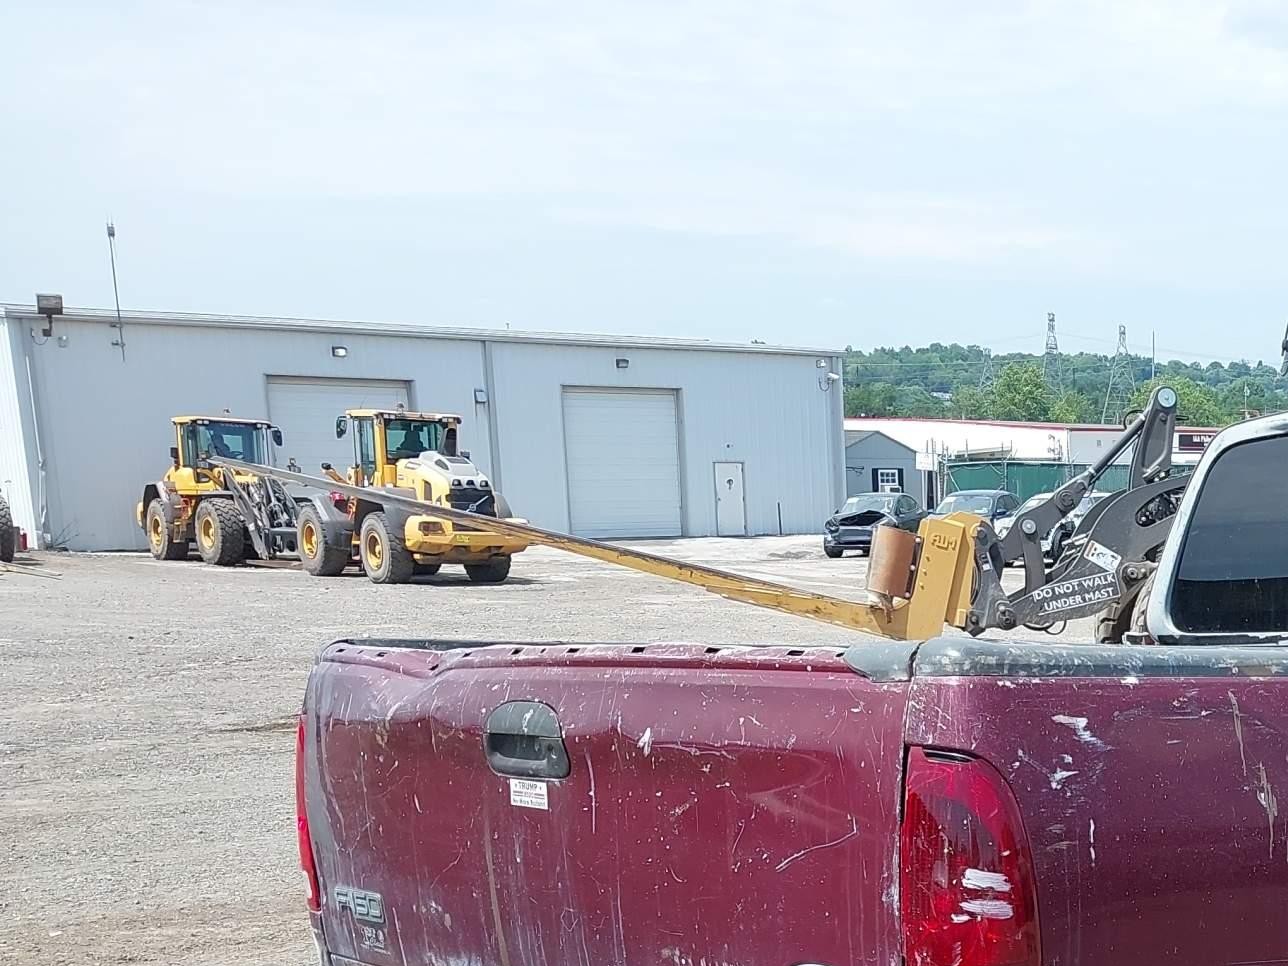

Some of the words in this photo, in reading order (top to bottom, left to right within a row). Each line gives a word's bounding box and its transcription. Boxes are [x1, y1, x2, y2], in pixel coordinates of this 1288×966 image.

[1035, 590, 1053, 600] DO
[1055, 582, 1079, 596] NOT
[1082, 573, 1115, 589] WALK
[1044, 594, 1083, 611] UNDER
[1085, 587, 1114, 601] MAST
[518, 781, 538, 792] TRUMP
